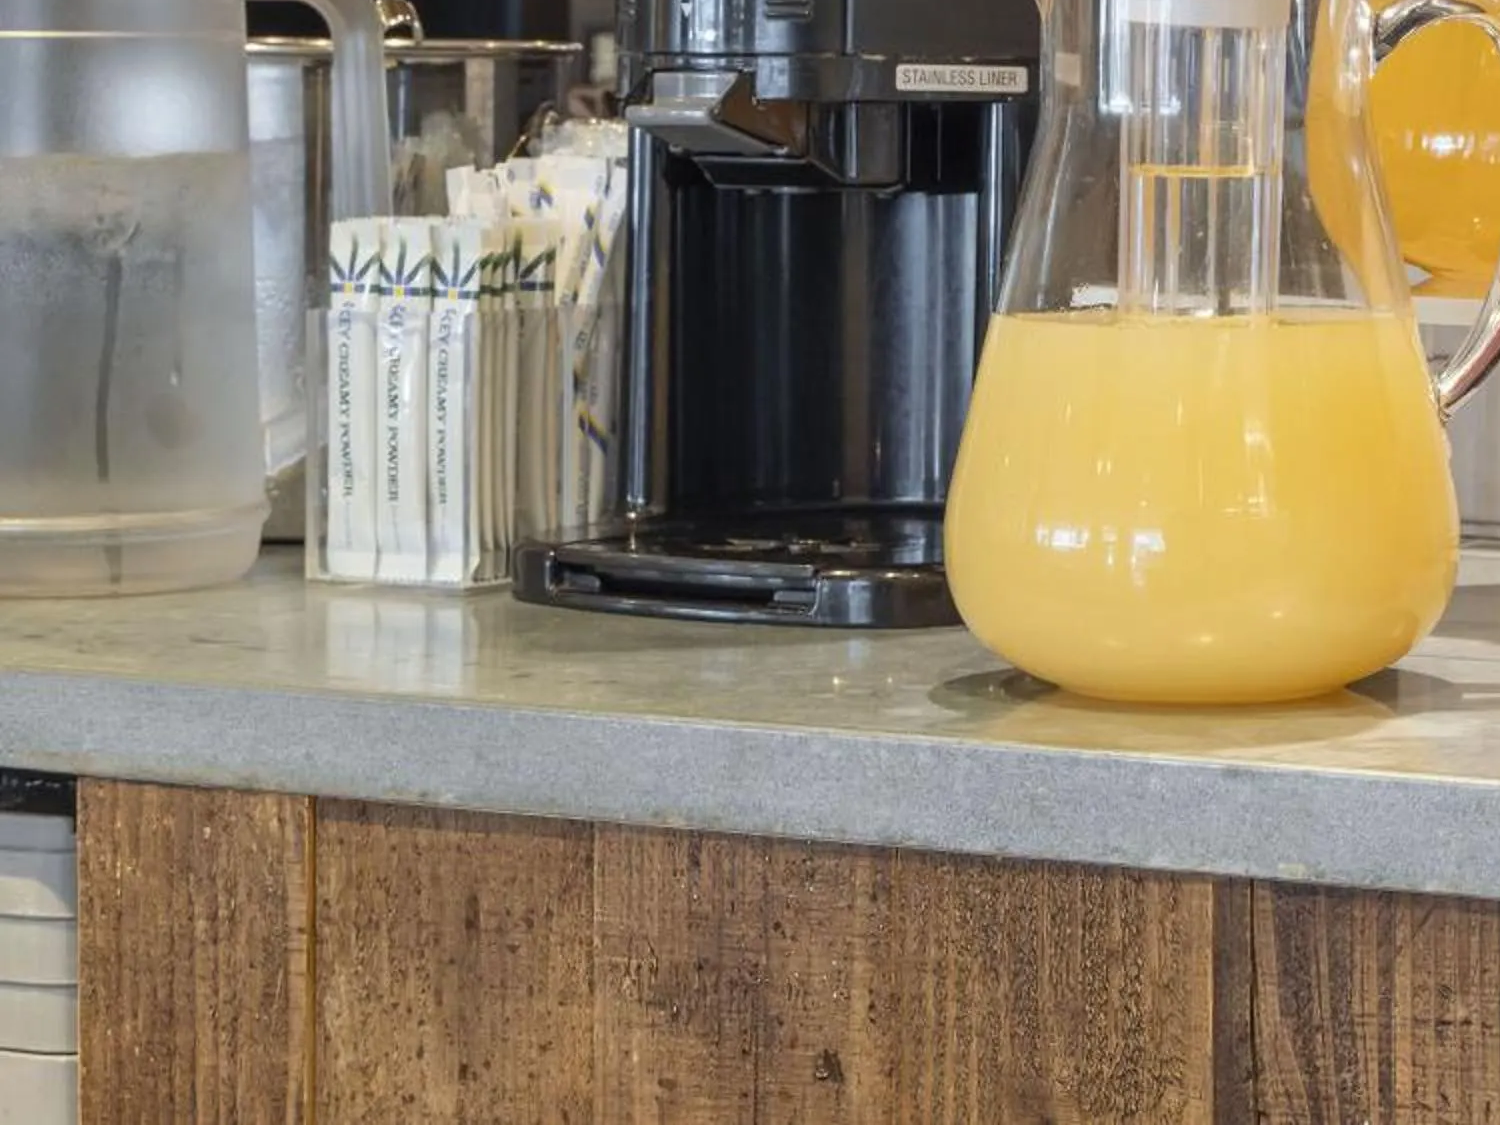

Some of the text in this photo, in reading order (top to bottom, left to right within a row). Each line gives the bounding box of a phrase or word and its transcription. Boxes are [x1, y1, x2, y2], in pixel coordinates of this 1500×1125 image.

[902, 68, 1018, 87] STAINLESS LINER
[338, 342, 351, 419] CREAMY
[340, 421, 354, 497] POWDER
[387, 424, 399, 502] POWDER
